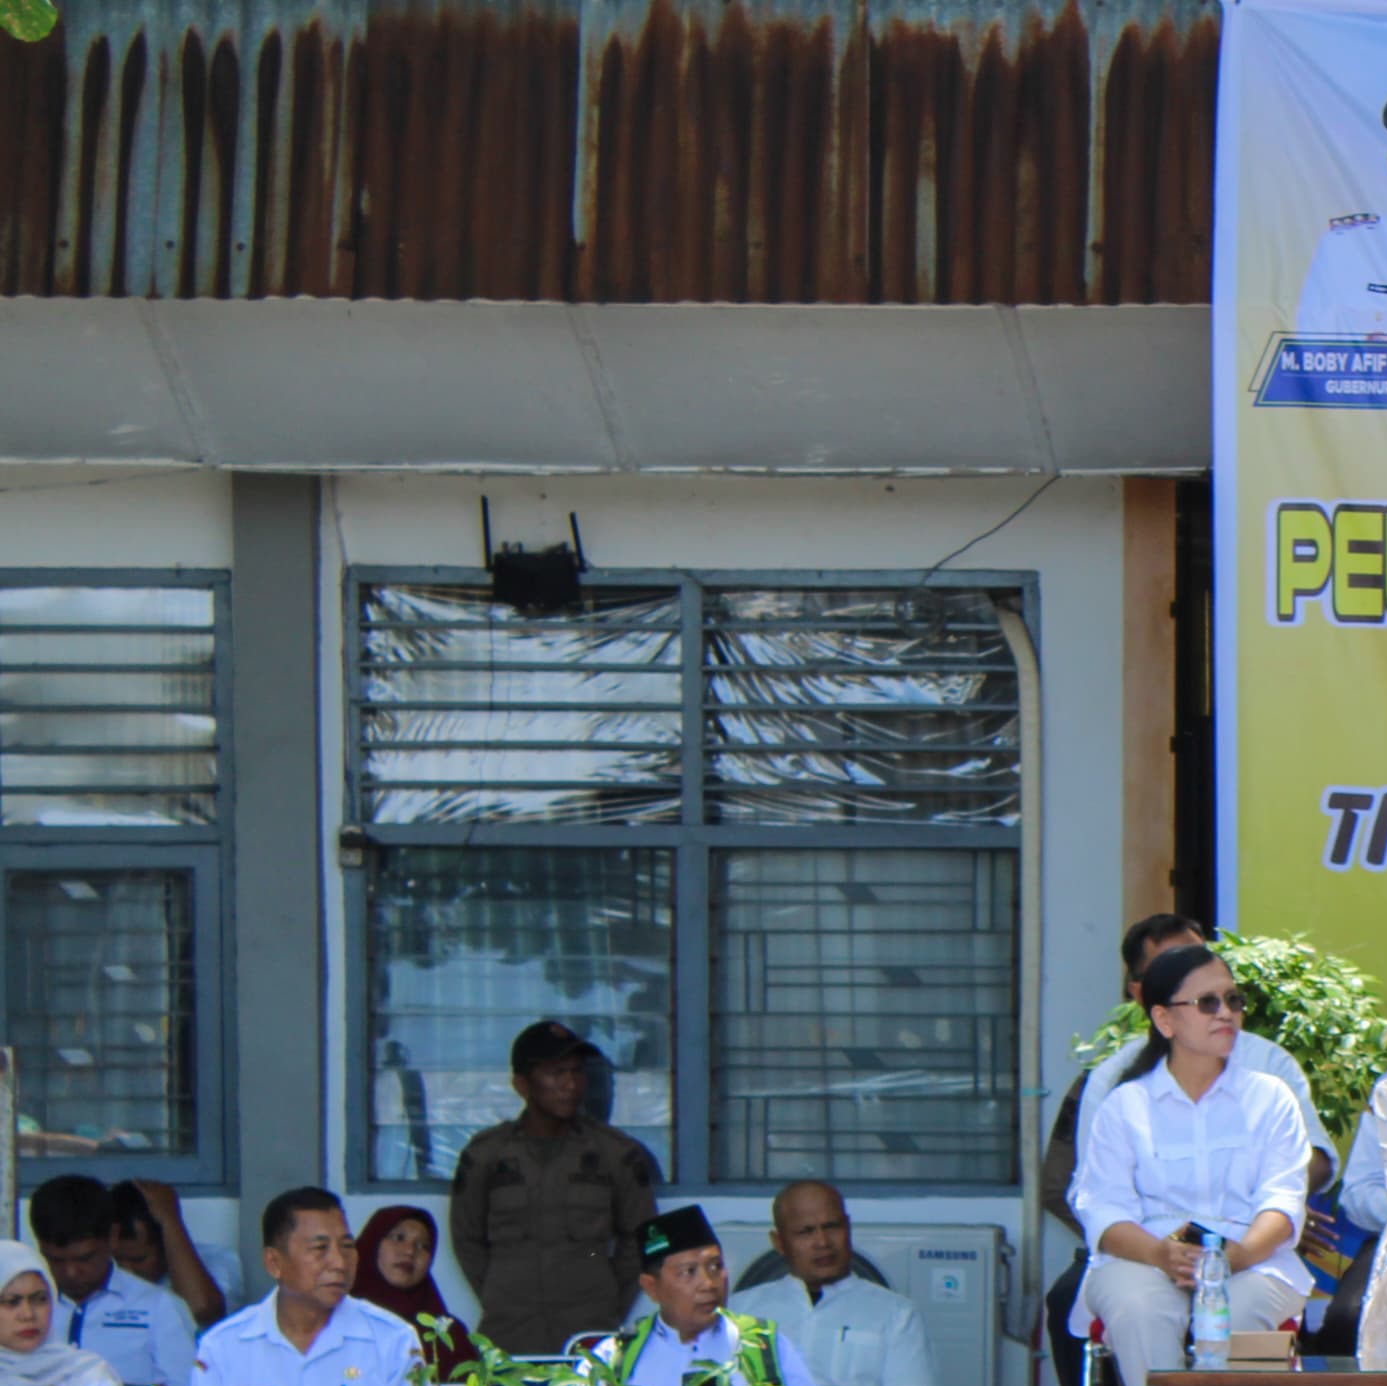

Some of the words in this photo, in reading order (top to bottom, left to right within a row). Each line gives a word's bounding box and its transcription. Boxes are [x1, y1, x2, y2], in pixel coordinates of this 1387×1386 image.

[1281, 352, 1300, 371] M.
[1303, 353, 1348, 373] BOBY
[1351, 354, 1387, 373] AFIF
[917, 1249, 978, 1261] SAMSUNG
